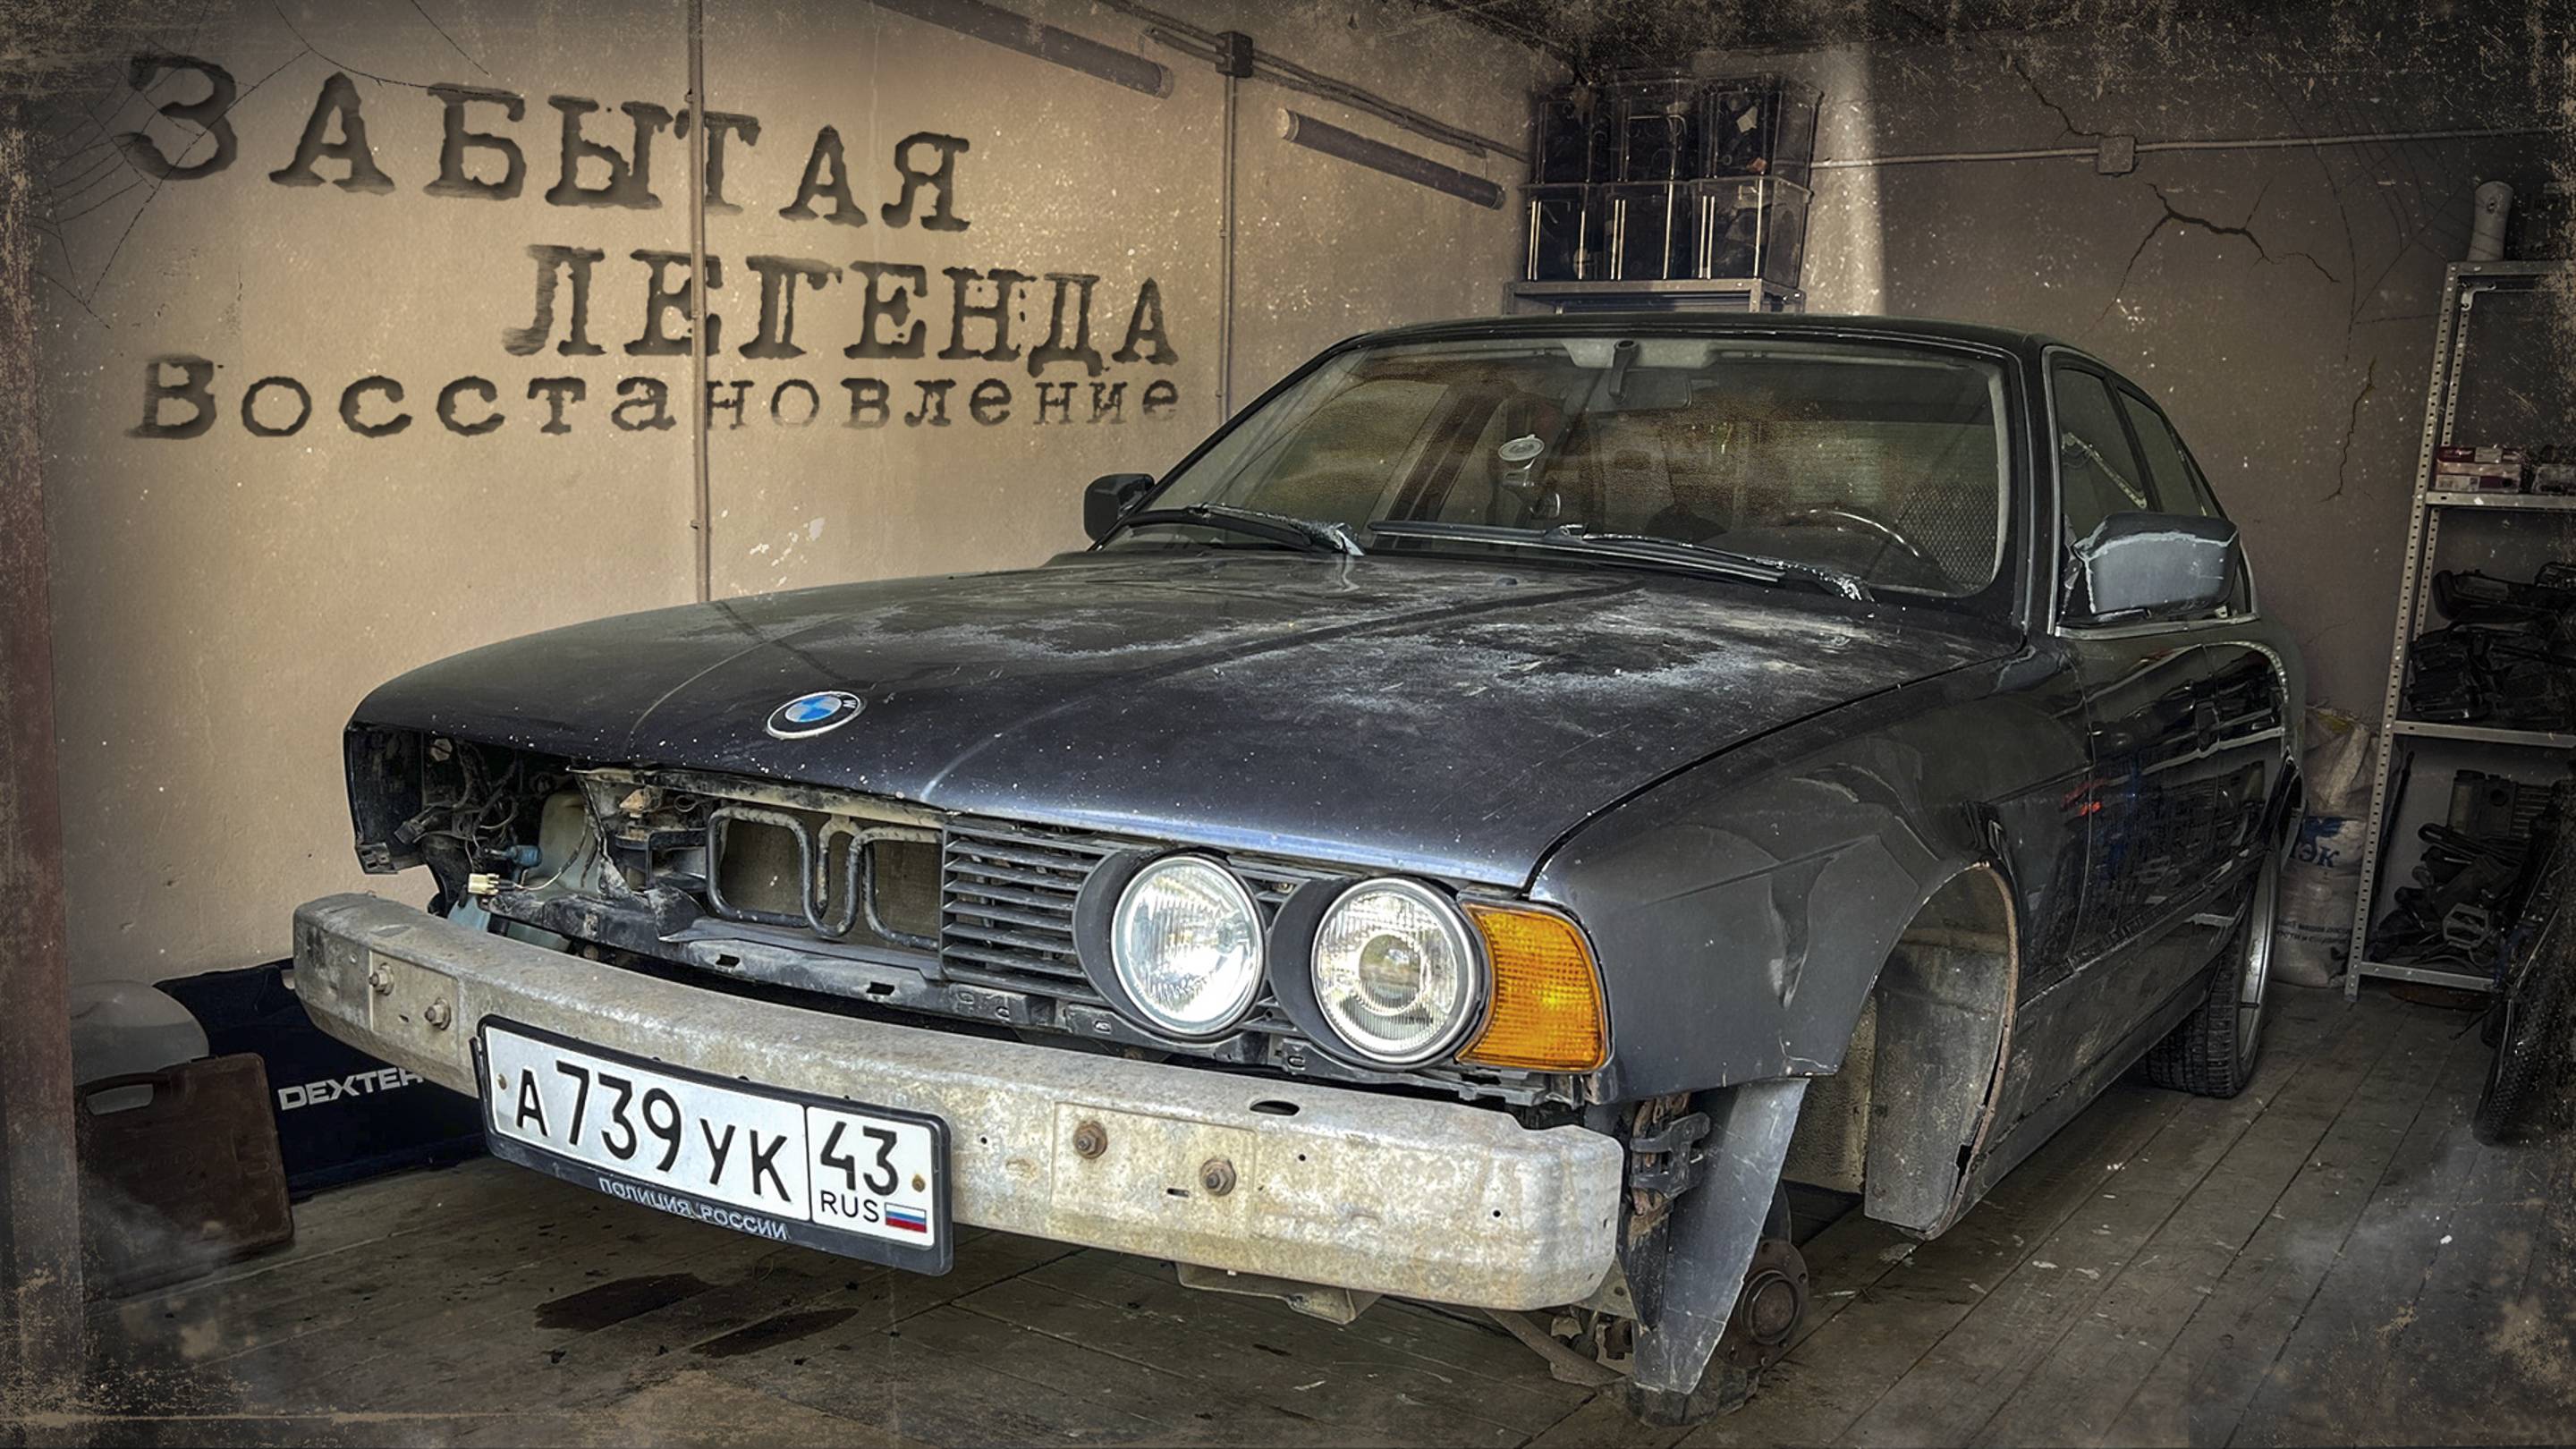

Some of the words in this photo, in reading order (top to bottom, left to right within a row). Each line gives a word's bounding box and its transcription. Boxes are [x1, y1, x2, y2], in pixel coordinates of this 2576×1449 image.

[819, 1121, 897, 1197] 43
[598, 1177, 689, 1216] ПОЛИЦИЯ
[700, 1205, 787, 1240] РОССИИ
[820, 1194, 879, 1224] RUS
